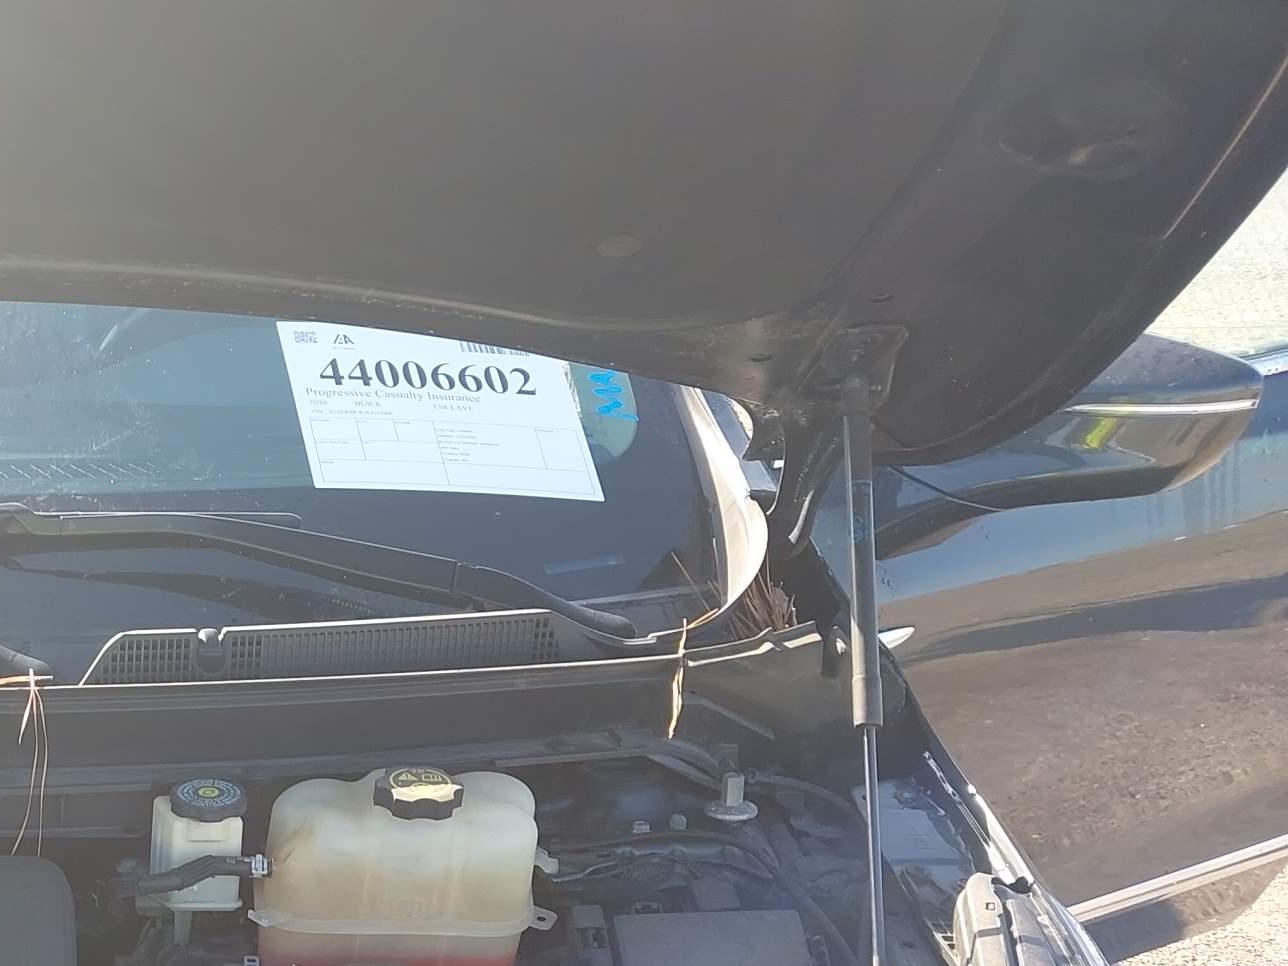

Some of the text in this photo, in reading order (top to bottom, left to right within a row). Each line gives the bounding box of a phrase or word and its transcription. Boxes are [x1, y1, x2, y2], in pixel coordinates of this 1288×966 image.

[319, 357, 537, 396] 44006602
[305, 386, 481, 403] Progressive Casualty Insurance
